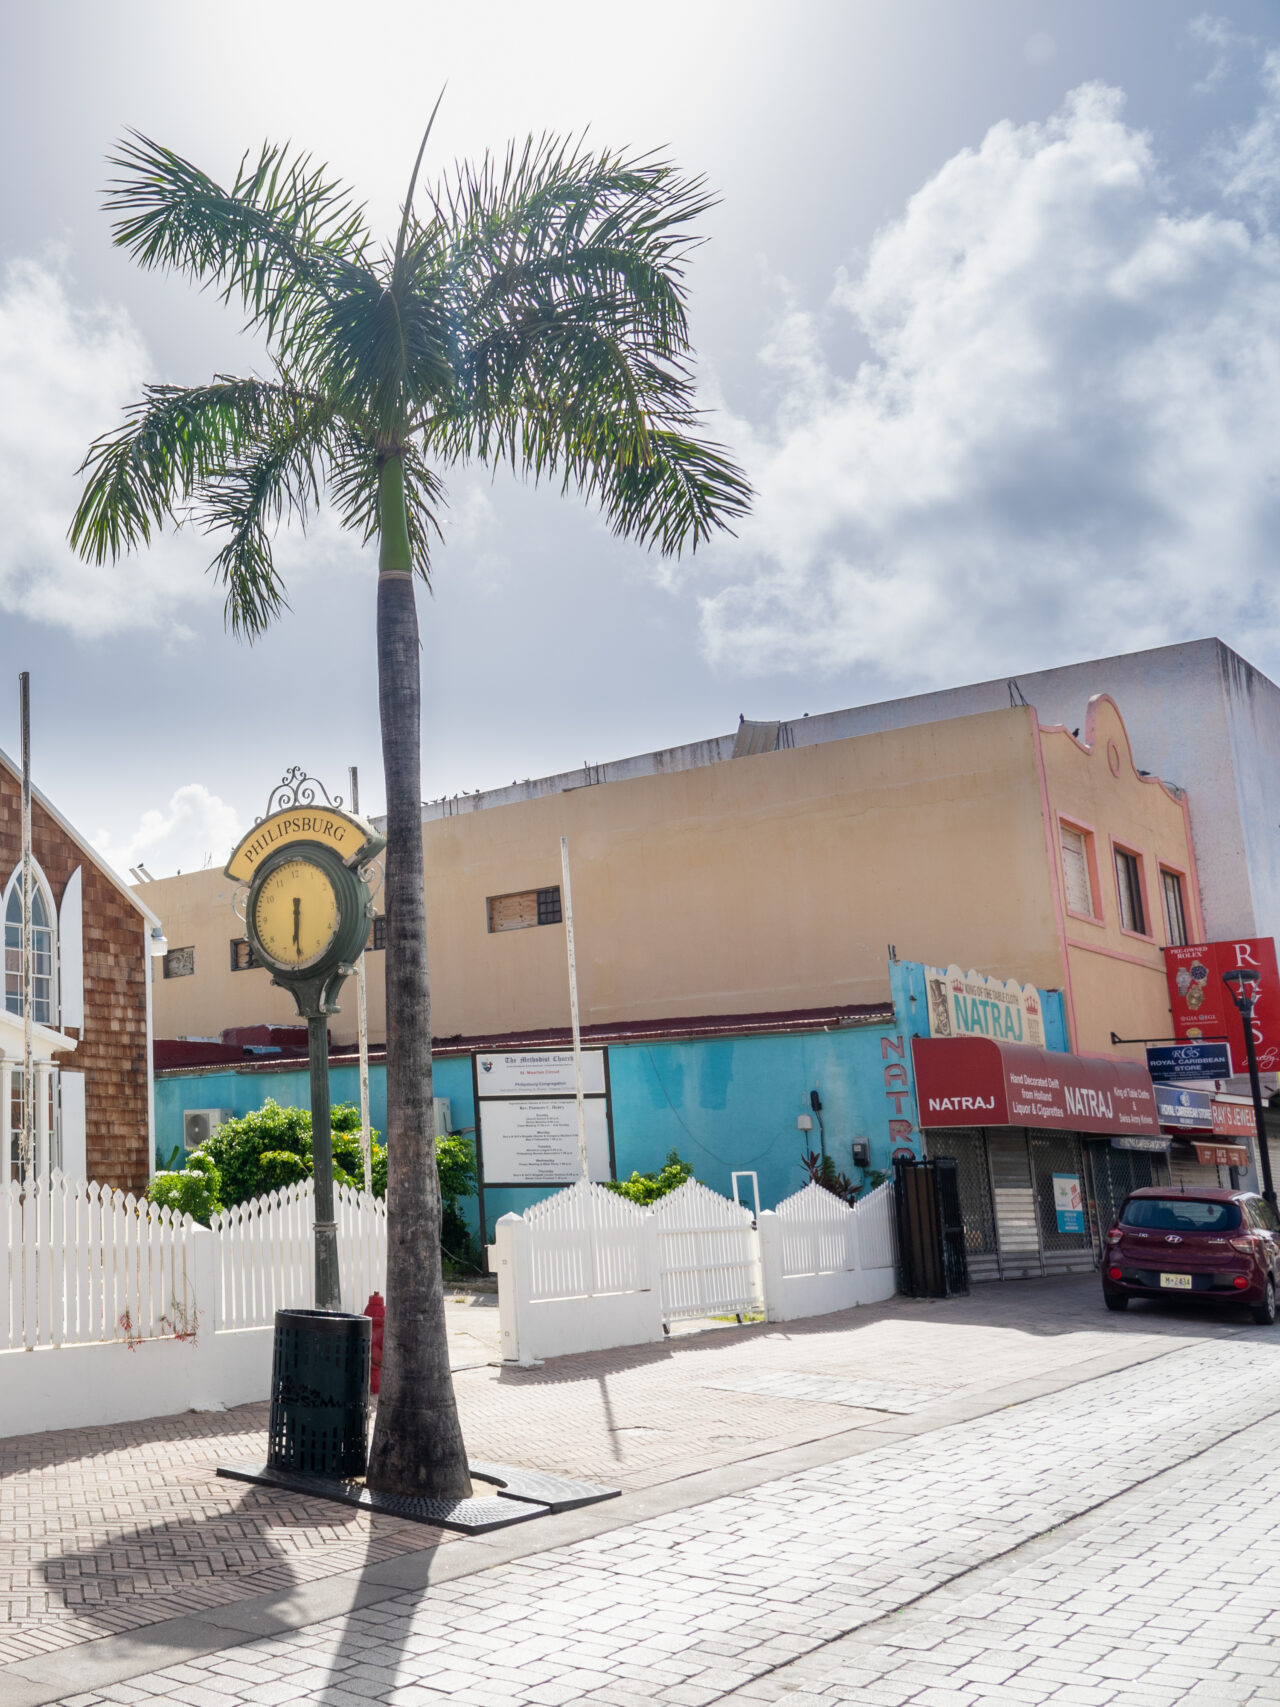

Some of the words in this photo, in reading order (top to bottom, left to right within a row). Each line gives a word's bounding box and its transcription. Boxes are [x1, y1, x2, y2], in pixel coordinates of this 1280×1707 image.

[244, 816, 346, 864] PHILIPSBURG
[1170, 946, 1208, 954] PRE-OWNED
[1177, 951, 1203, 959] ROLEX
[953, 993, 1023, 1042] NATRAJ
[505, 1056, 517, 1064] The
[520, 1056, 550, 1064] Methodist
[552, 1055, 574, 1063] Church
[1178, 1056, 1226, 1065] CARIBBEAN
[1174, 1064, 1202, 1072] STORE
[1010, 1072, 1024, 1084] Hand
[1023, 1074, 1048, 1088] Decorated
[928, 1095, 996, 1111] NATRAJ
[1021, 1088, 1034, 1099] from
[1033, 1089, 1052, 1102] Holland
[1064, 1085, 1114, 1119] NATRAJ
[1012, 1100, 1031, 1116] Liquor
[1031, 1102, 1036, 1115] &
[1036, 1103, 1064, 1118] Cigarettes
[1211, 1105, 1233, 1125] RAY'S
